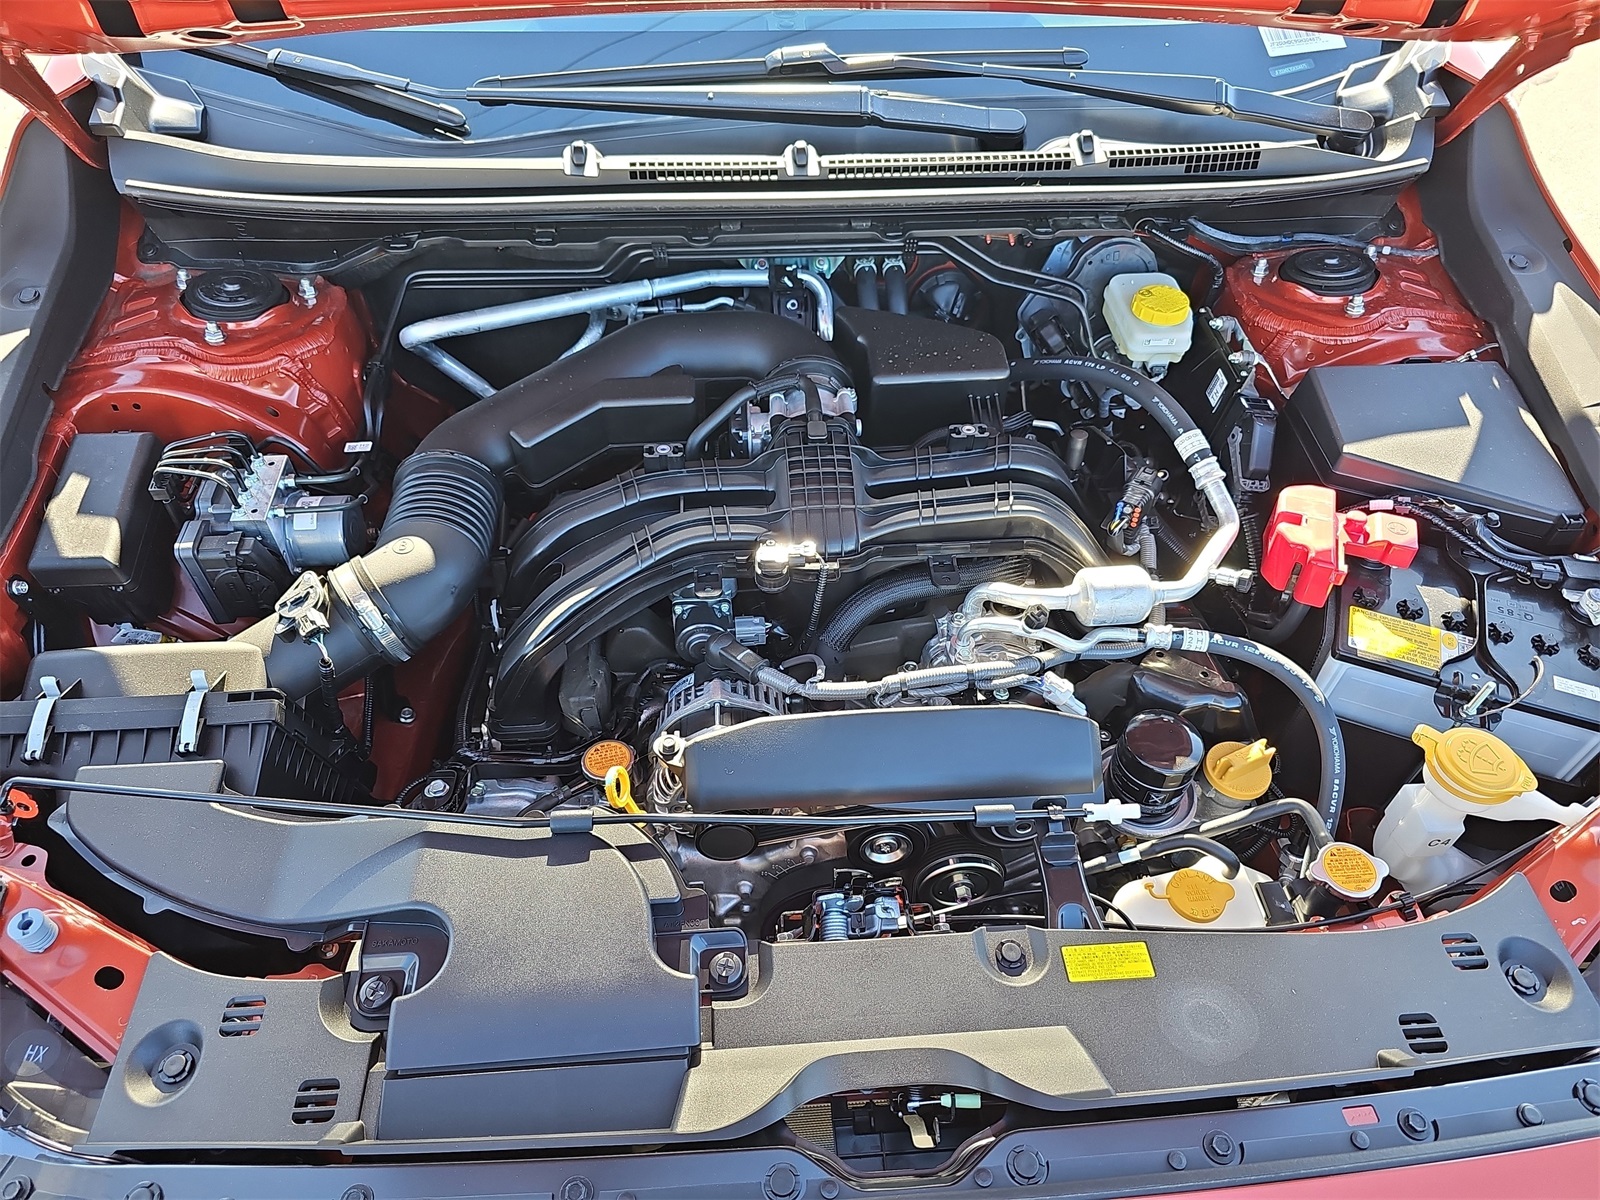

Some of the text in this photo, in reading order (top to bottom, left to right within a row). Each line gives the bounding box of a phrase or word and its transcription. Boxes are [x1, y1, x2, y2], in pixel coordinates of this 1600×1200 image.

[1157, 402, 1179, 426] YOKOHAMA
[1352, 607, 1378, 618] DANGER
[1497, 606, 1534, 621] Q-85
[1210, 637, 1239, 648] ACVR
[1331, 735, 1341, 774] YOKOHAMA
[1428, 838, 1451, 849] C4
[1170, 870, 1216, 889] COOLANT
[371, 937, 419, 948] SAKAMOTO
[23, 1044, 49, 1064] HX
